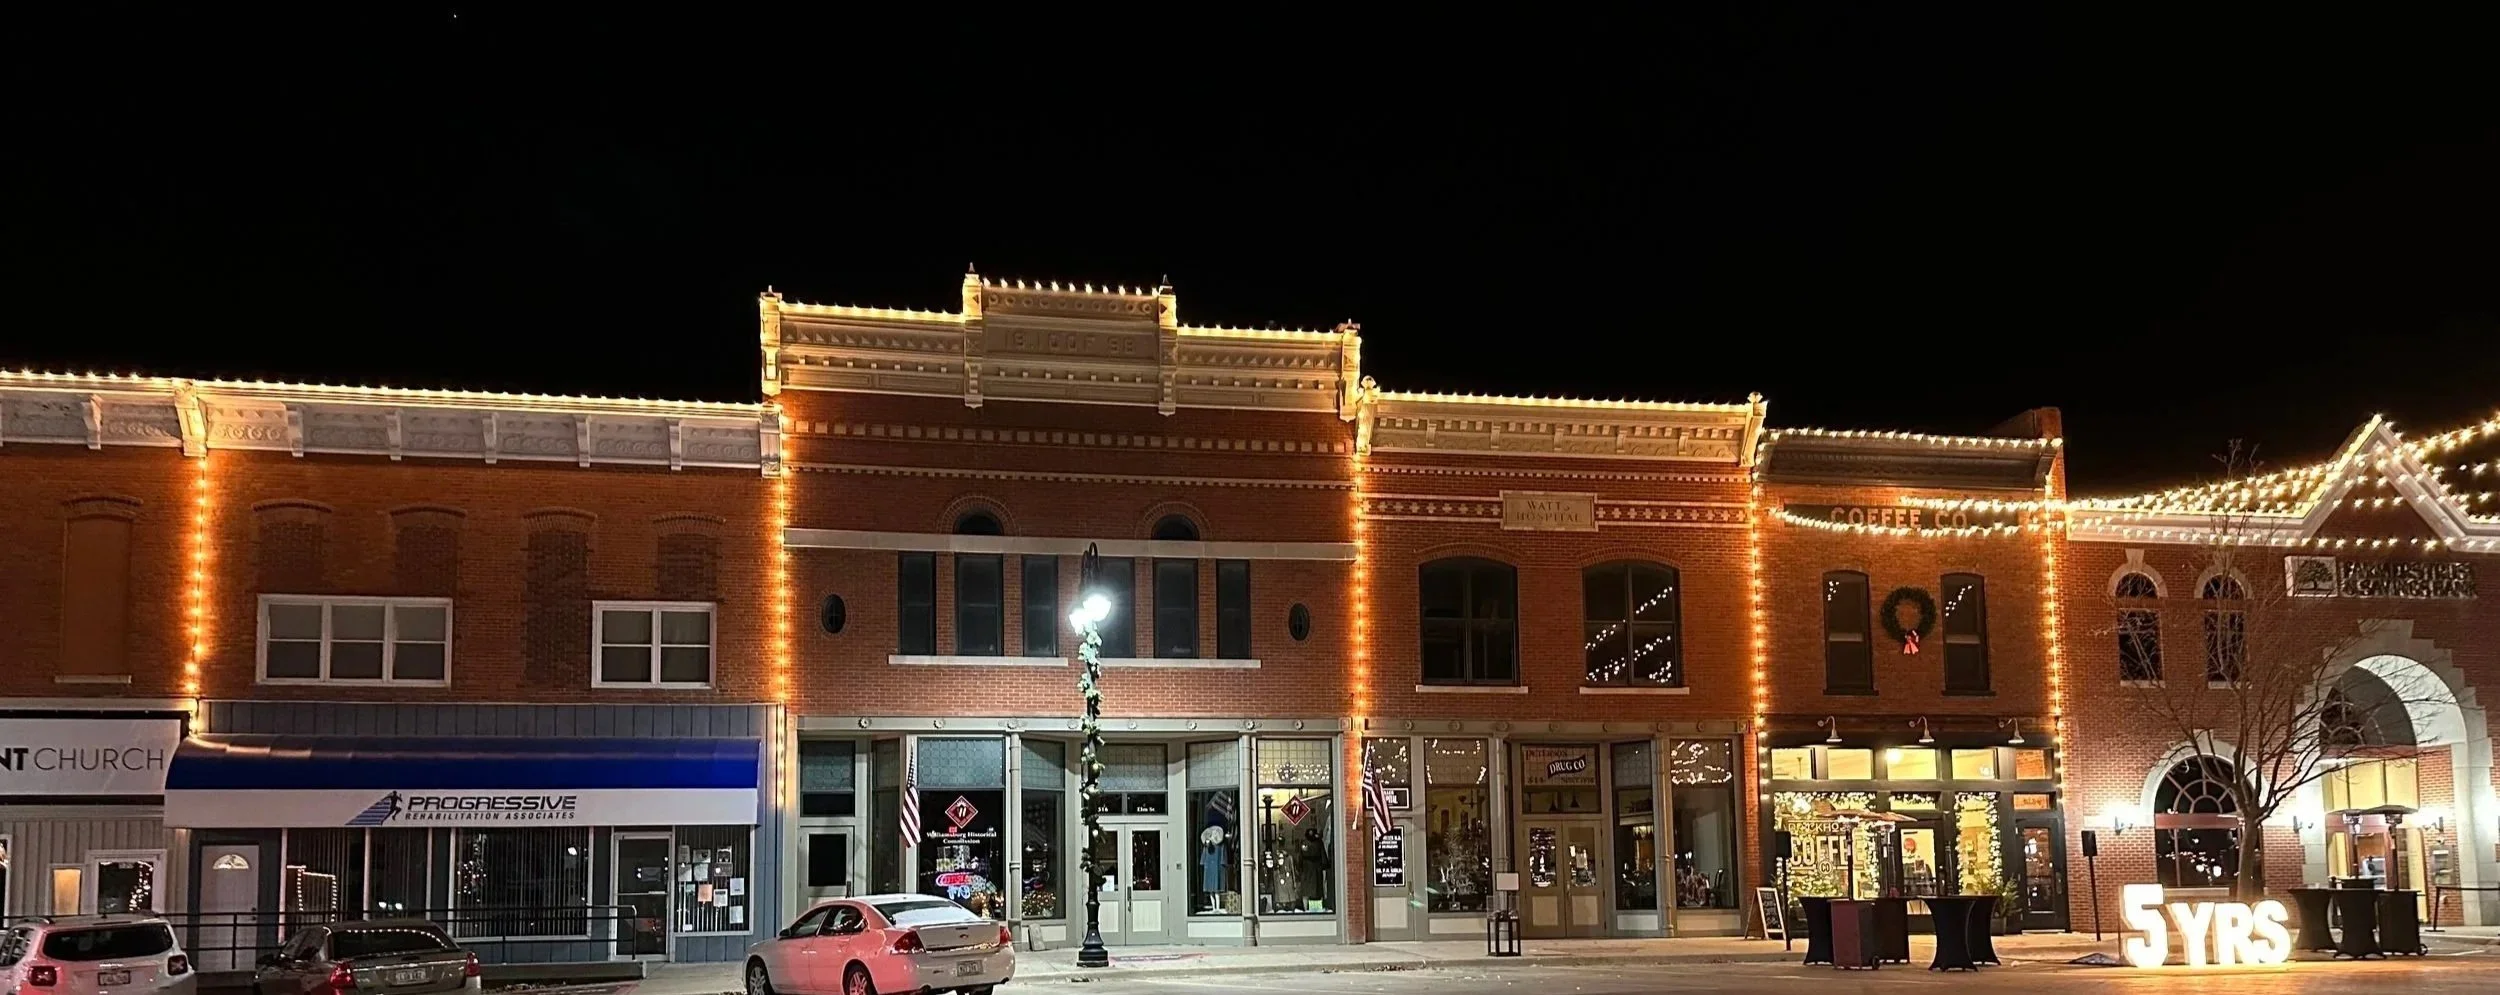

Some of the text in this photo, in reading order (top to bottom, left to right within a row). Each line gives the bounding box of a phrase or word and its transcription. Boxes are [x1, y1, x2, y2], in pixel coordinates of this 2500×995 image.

[1516, 511, 1578, 522] HOSPITAL
[1831, 507, 1921, 529] COFFEE
[34, 747, 164, 771] CHURCH
[1549, 759, 1586, 775] DRUG CO
[407, 795, 577, 811] PROGRESSIVE
[405, 811, 575, 821] REHABILITATION ASSOCIATES
[1789, 834, 1865, 866] COFFEE
[2119, 883, 2292, 969] 5 YRS
